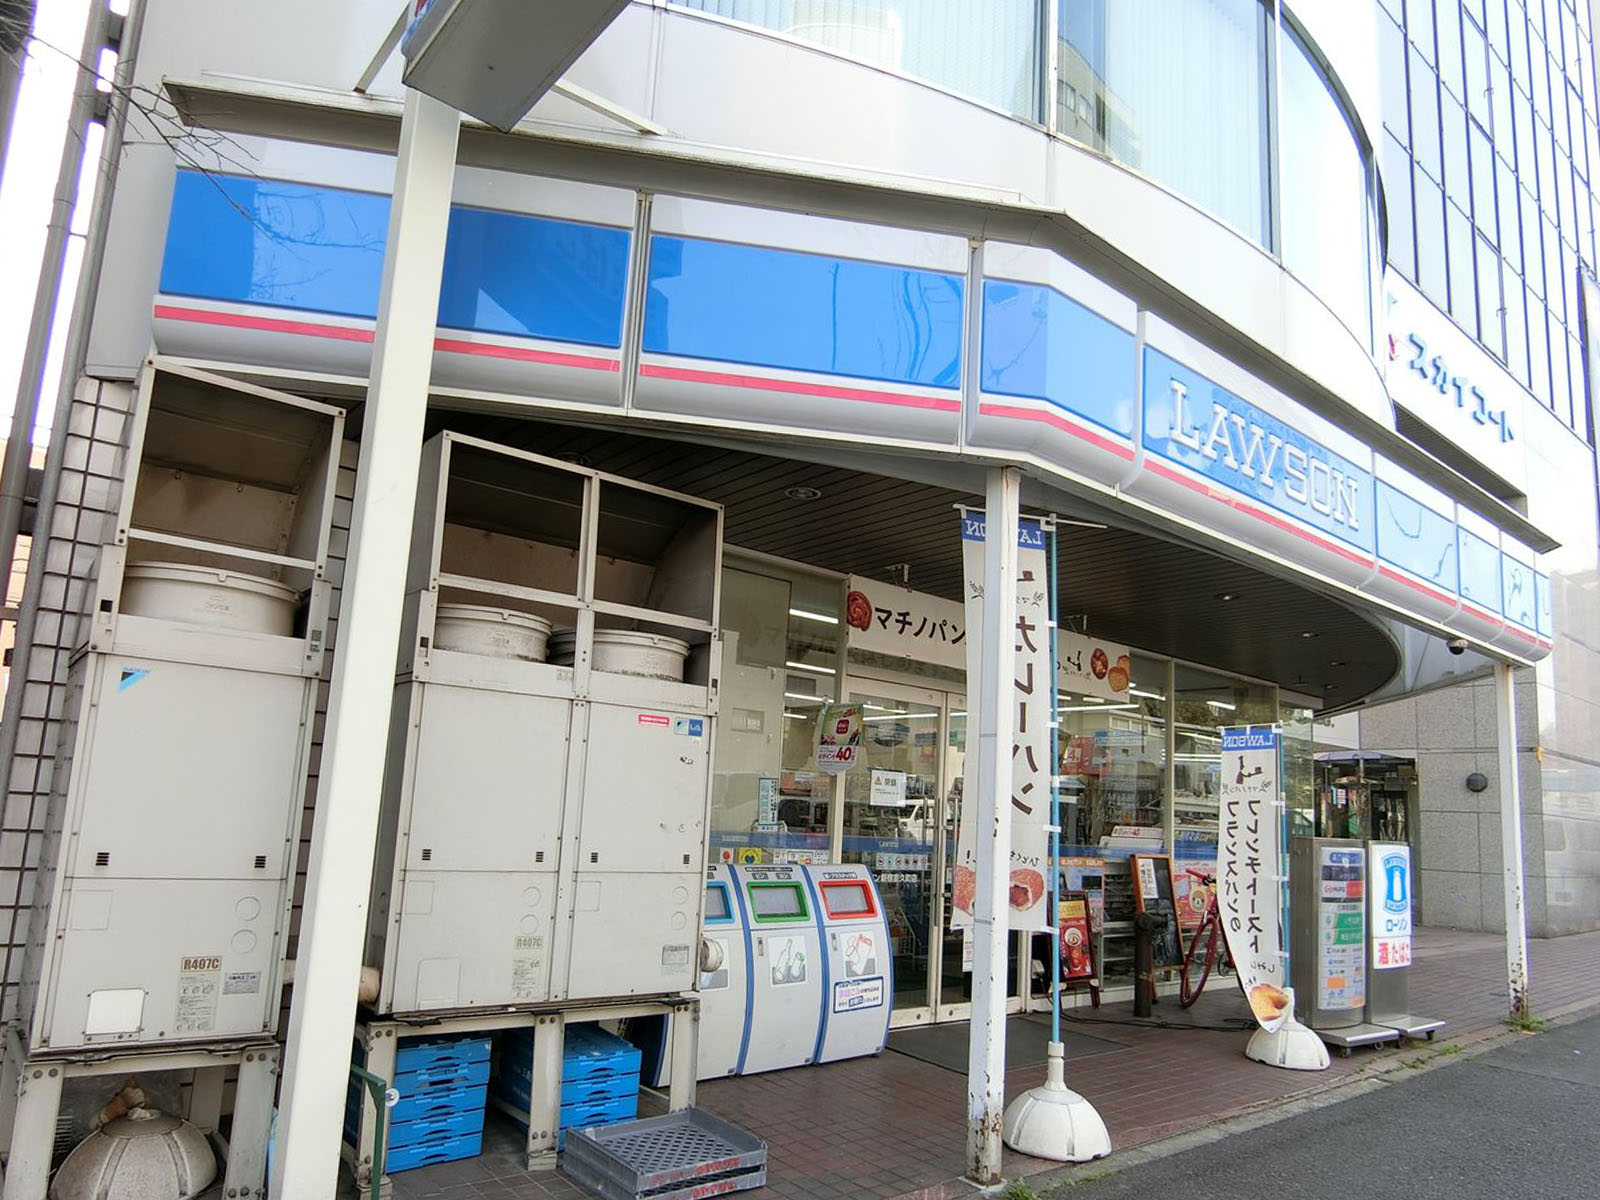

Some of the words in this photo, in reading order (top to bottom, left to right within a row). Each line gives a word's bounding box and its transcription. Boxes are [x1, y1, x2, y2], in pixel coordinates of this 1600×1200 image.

[1408, 332, 1515, 443] スカイコート
[1169, 378, 1359, 529] LAWSON
[874, 606, 965, 645] マチノパン
[1386, 917, 1408, 932] ローソン
[183, 957, 220, 971] R407C
